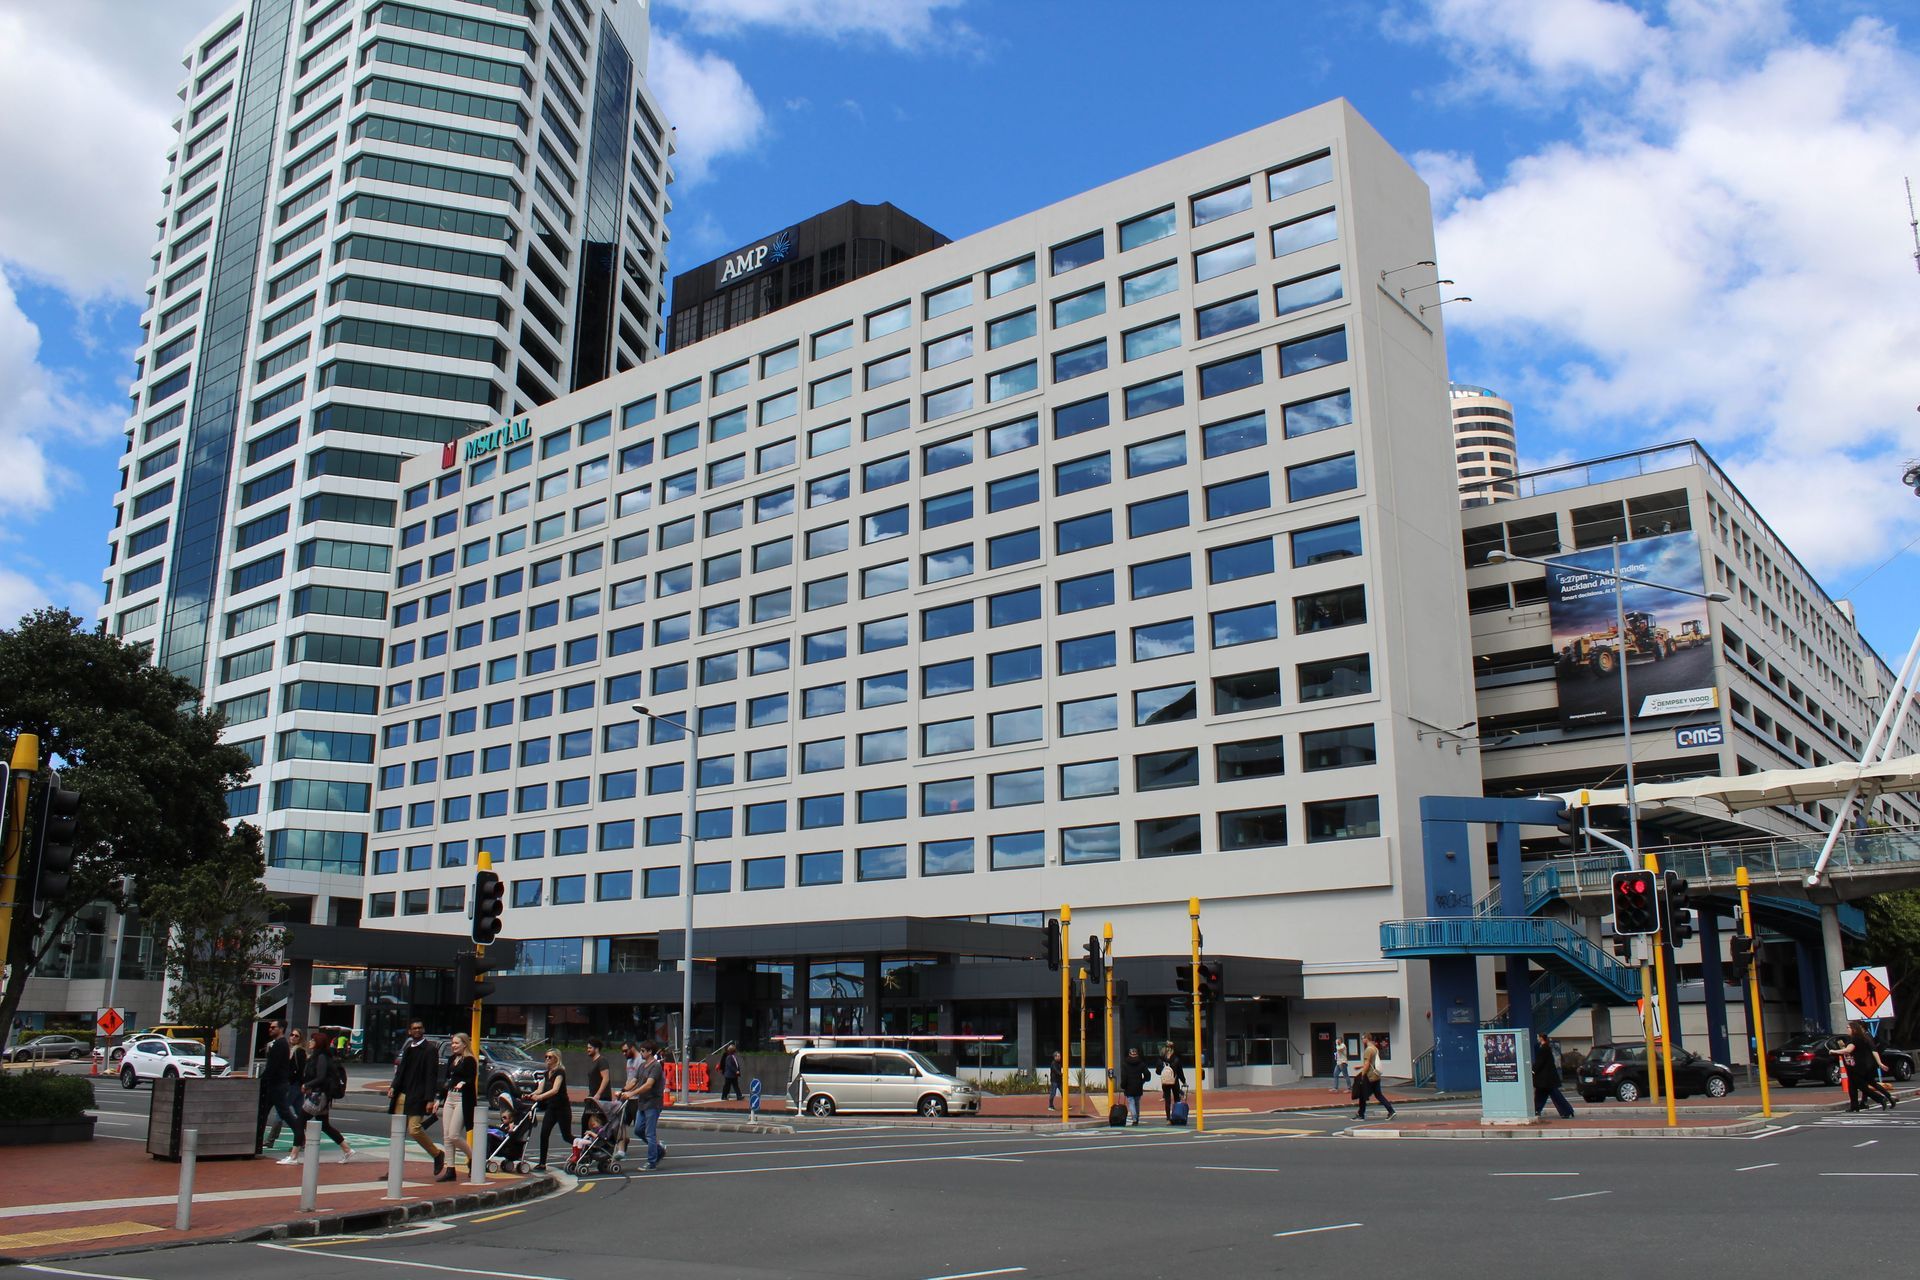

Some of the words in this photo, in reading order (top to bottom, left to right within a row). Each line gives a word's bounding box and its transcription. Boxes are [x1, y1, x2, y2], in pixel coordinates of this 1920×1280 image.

[721, 245, 768, 283] AMP
[1560, 573, 1588, 584] 5:27pm
[1561, 580, 1598, 593] Auckland
[1657, 698, 1687, 707] DEMPSEY
[1689, 695, 1710, 703] WOOD
[1678, 727, 1721, 746] QMS
